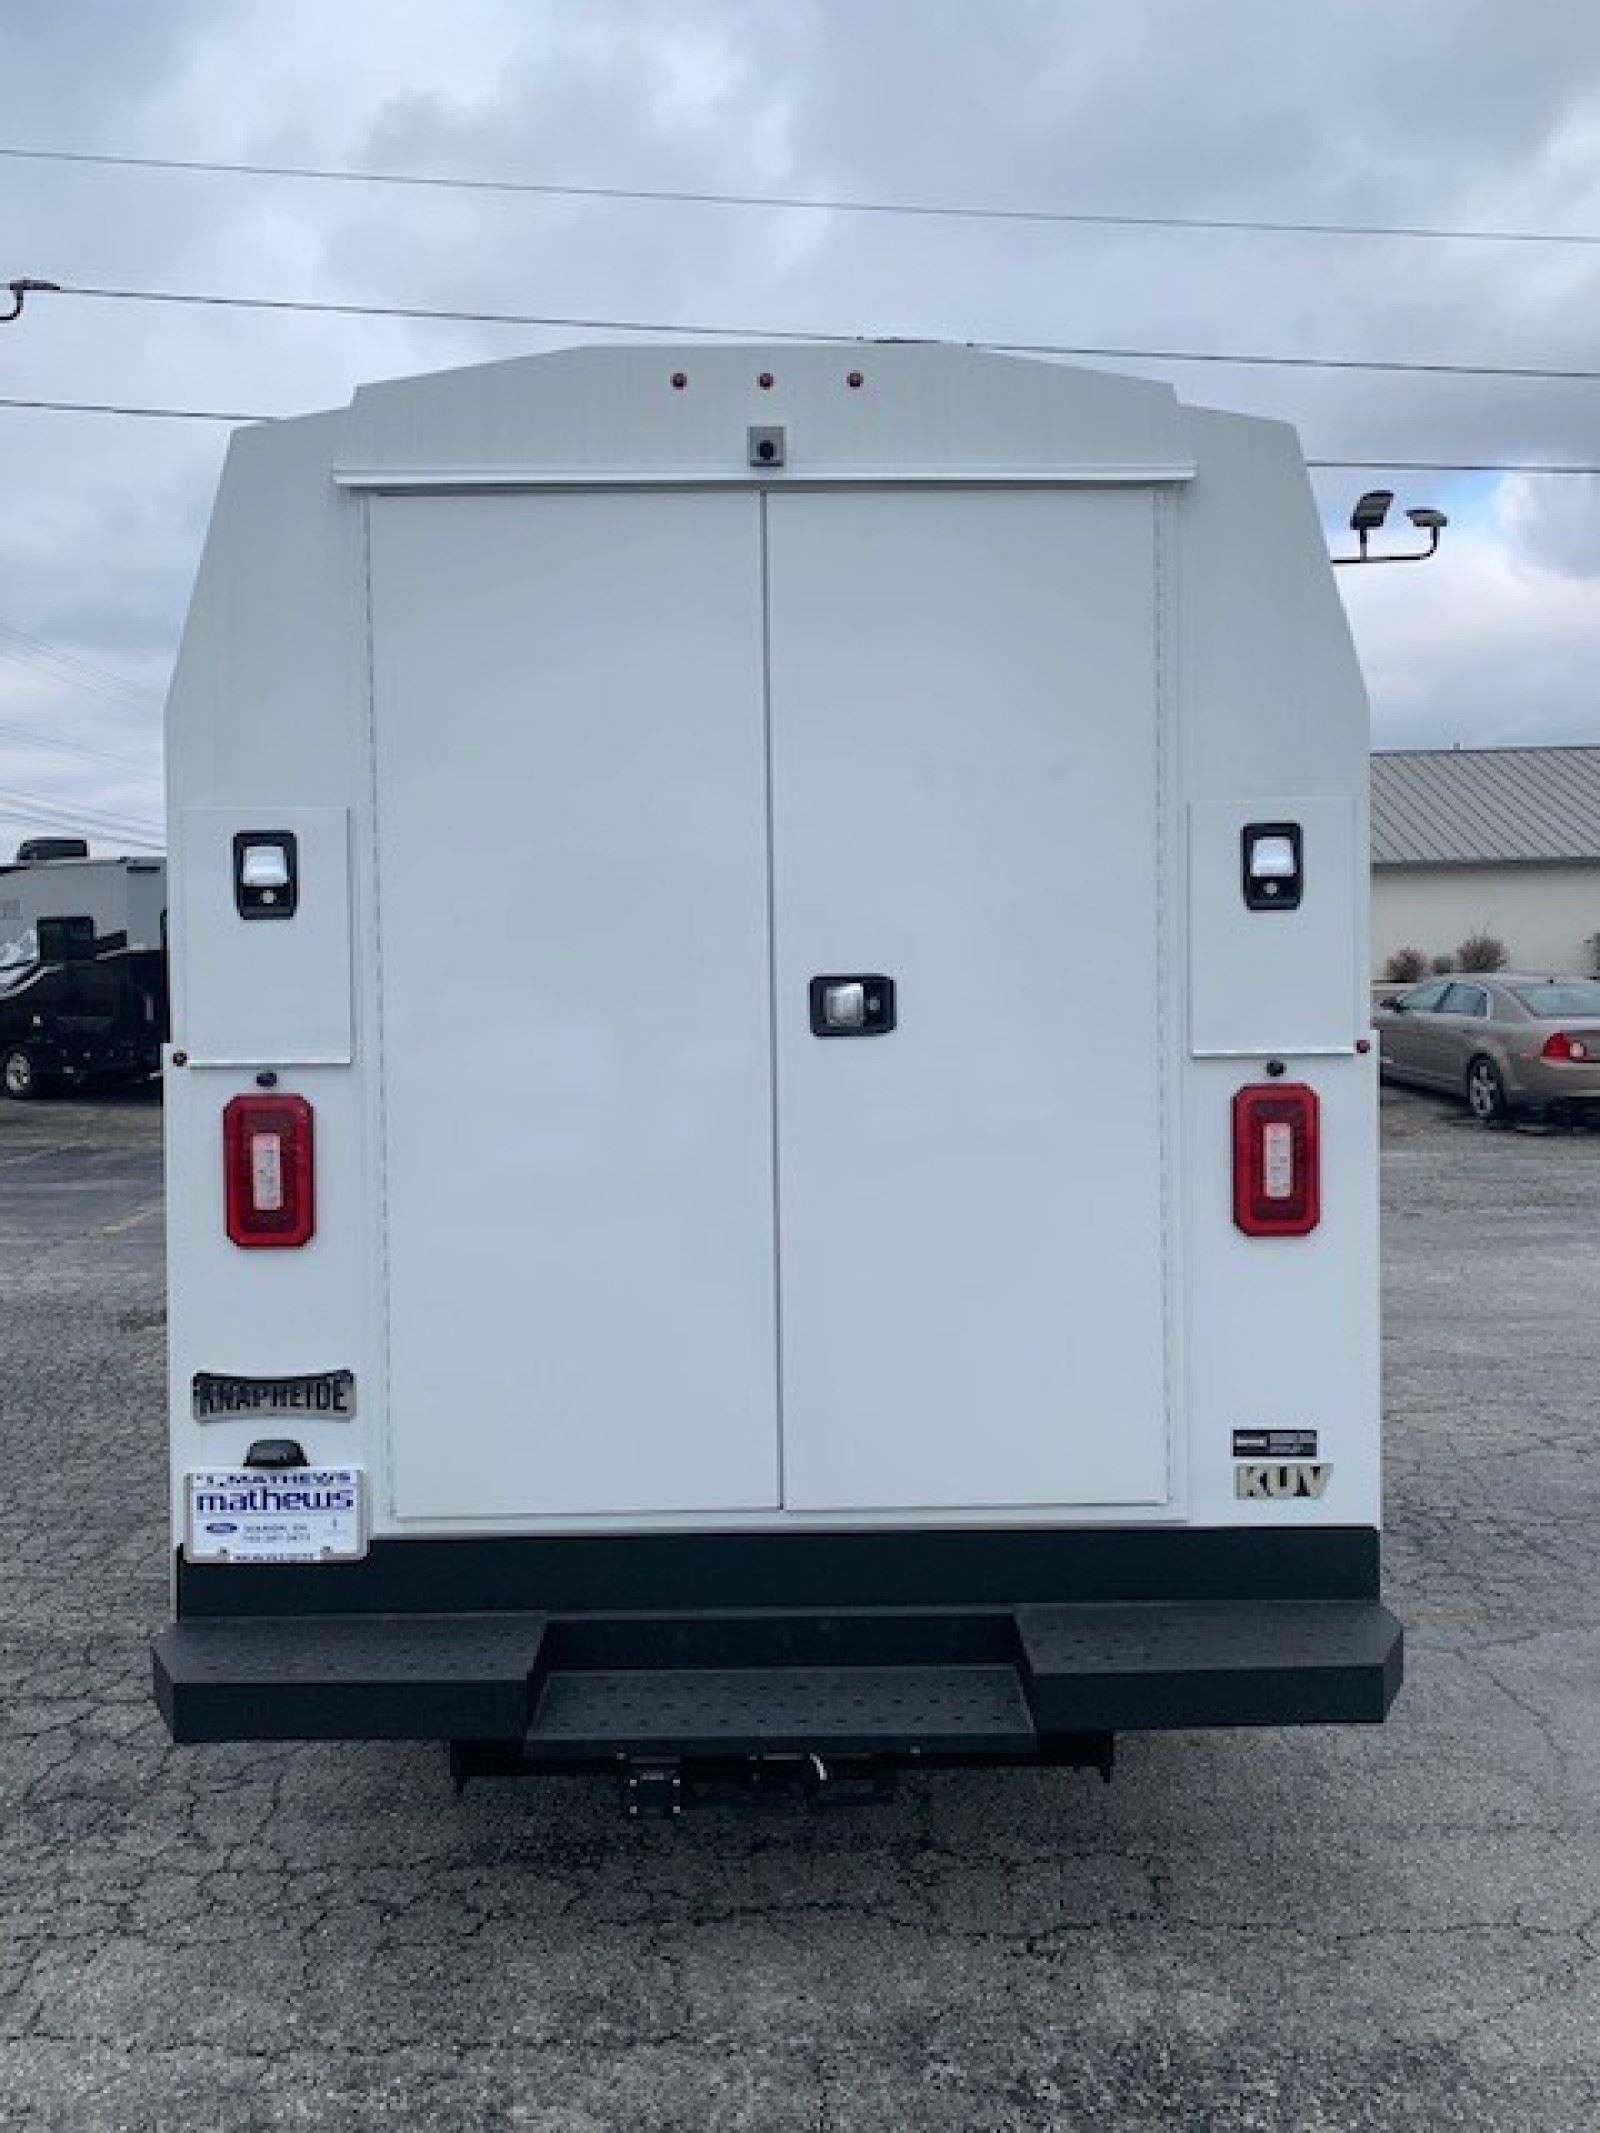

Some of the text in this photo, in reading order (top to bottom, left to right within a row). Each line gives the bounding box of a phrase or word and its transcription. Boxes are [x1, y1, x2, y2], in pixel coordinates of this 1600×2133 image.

[194, 1373, 353, 1418] KNAPHEIDE
[197, 1487, 354, 1511] mathews
[1233, 1463, 1333, 1500] KUV
